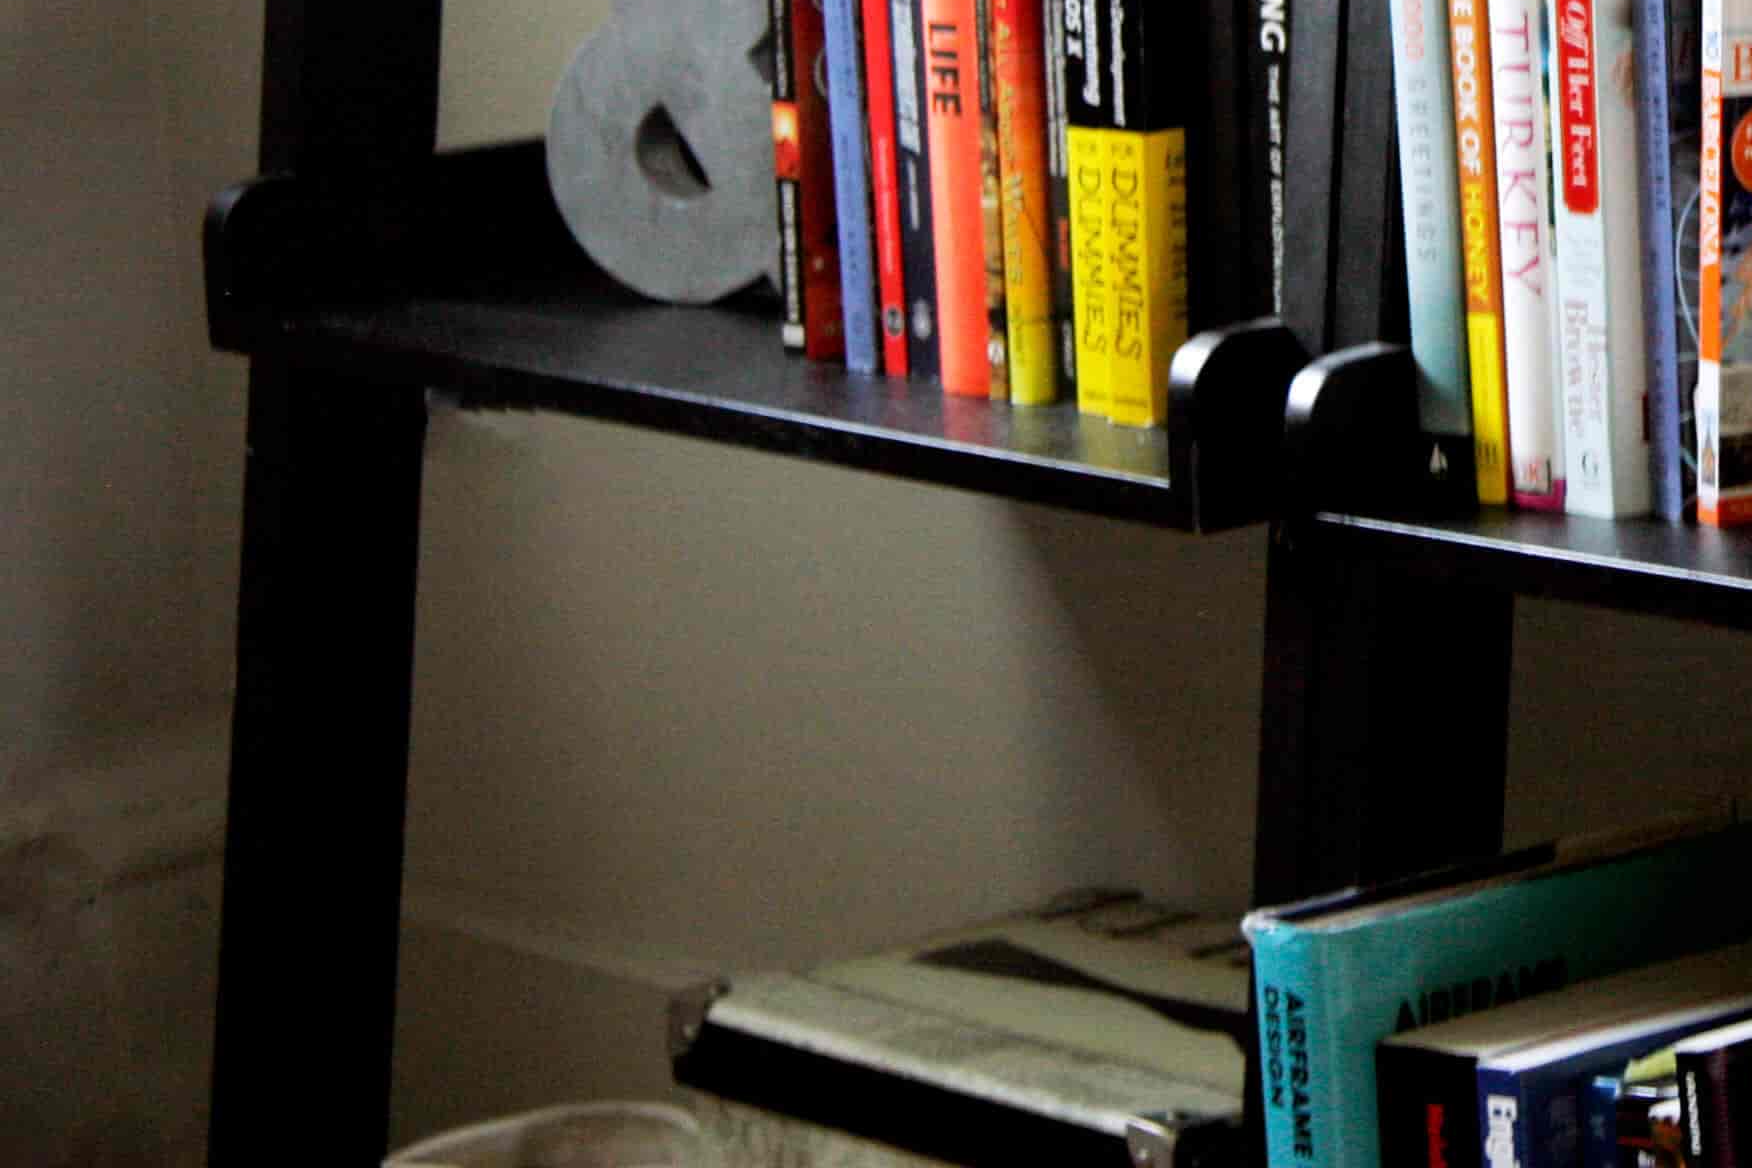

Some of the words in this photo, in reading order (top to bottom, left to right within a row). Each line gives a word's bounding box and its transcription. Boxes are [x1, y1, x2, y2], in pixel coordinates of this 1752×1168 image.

[928, 21, 962, 118] LIFE
[1066, 35, 1083, 60] X
[1454, 24, 1481, 122] BOOK
[1561, 0, 1590, 54] Off
[1568, 55, 1591, 117] Her
[1460, 129, 1485, 176] OF
[1496, 10, 1543, 297] TURKEY
[1569, 122, 1593, 189] Feet
[1701, 74, 1720, 266] BARCELONA
[1076, 164, 1107, 356] DUMMIES
[1108, 166, 1145, 363] DUMMIES
[1464, 181, 1492, 306] HONEY
[1265, 985, 1284, 1109] DESIGN
[1286, 991, 1314, 1160] AIRFRAME
